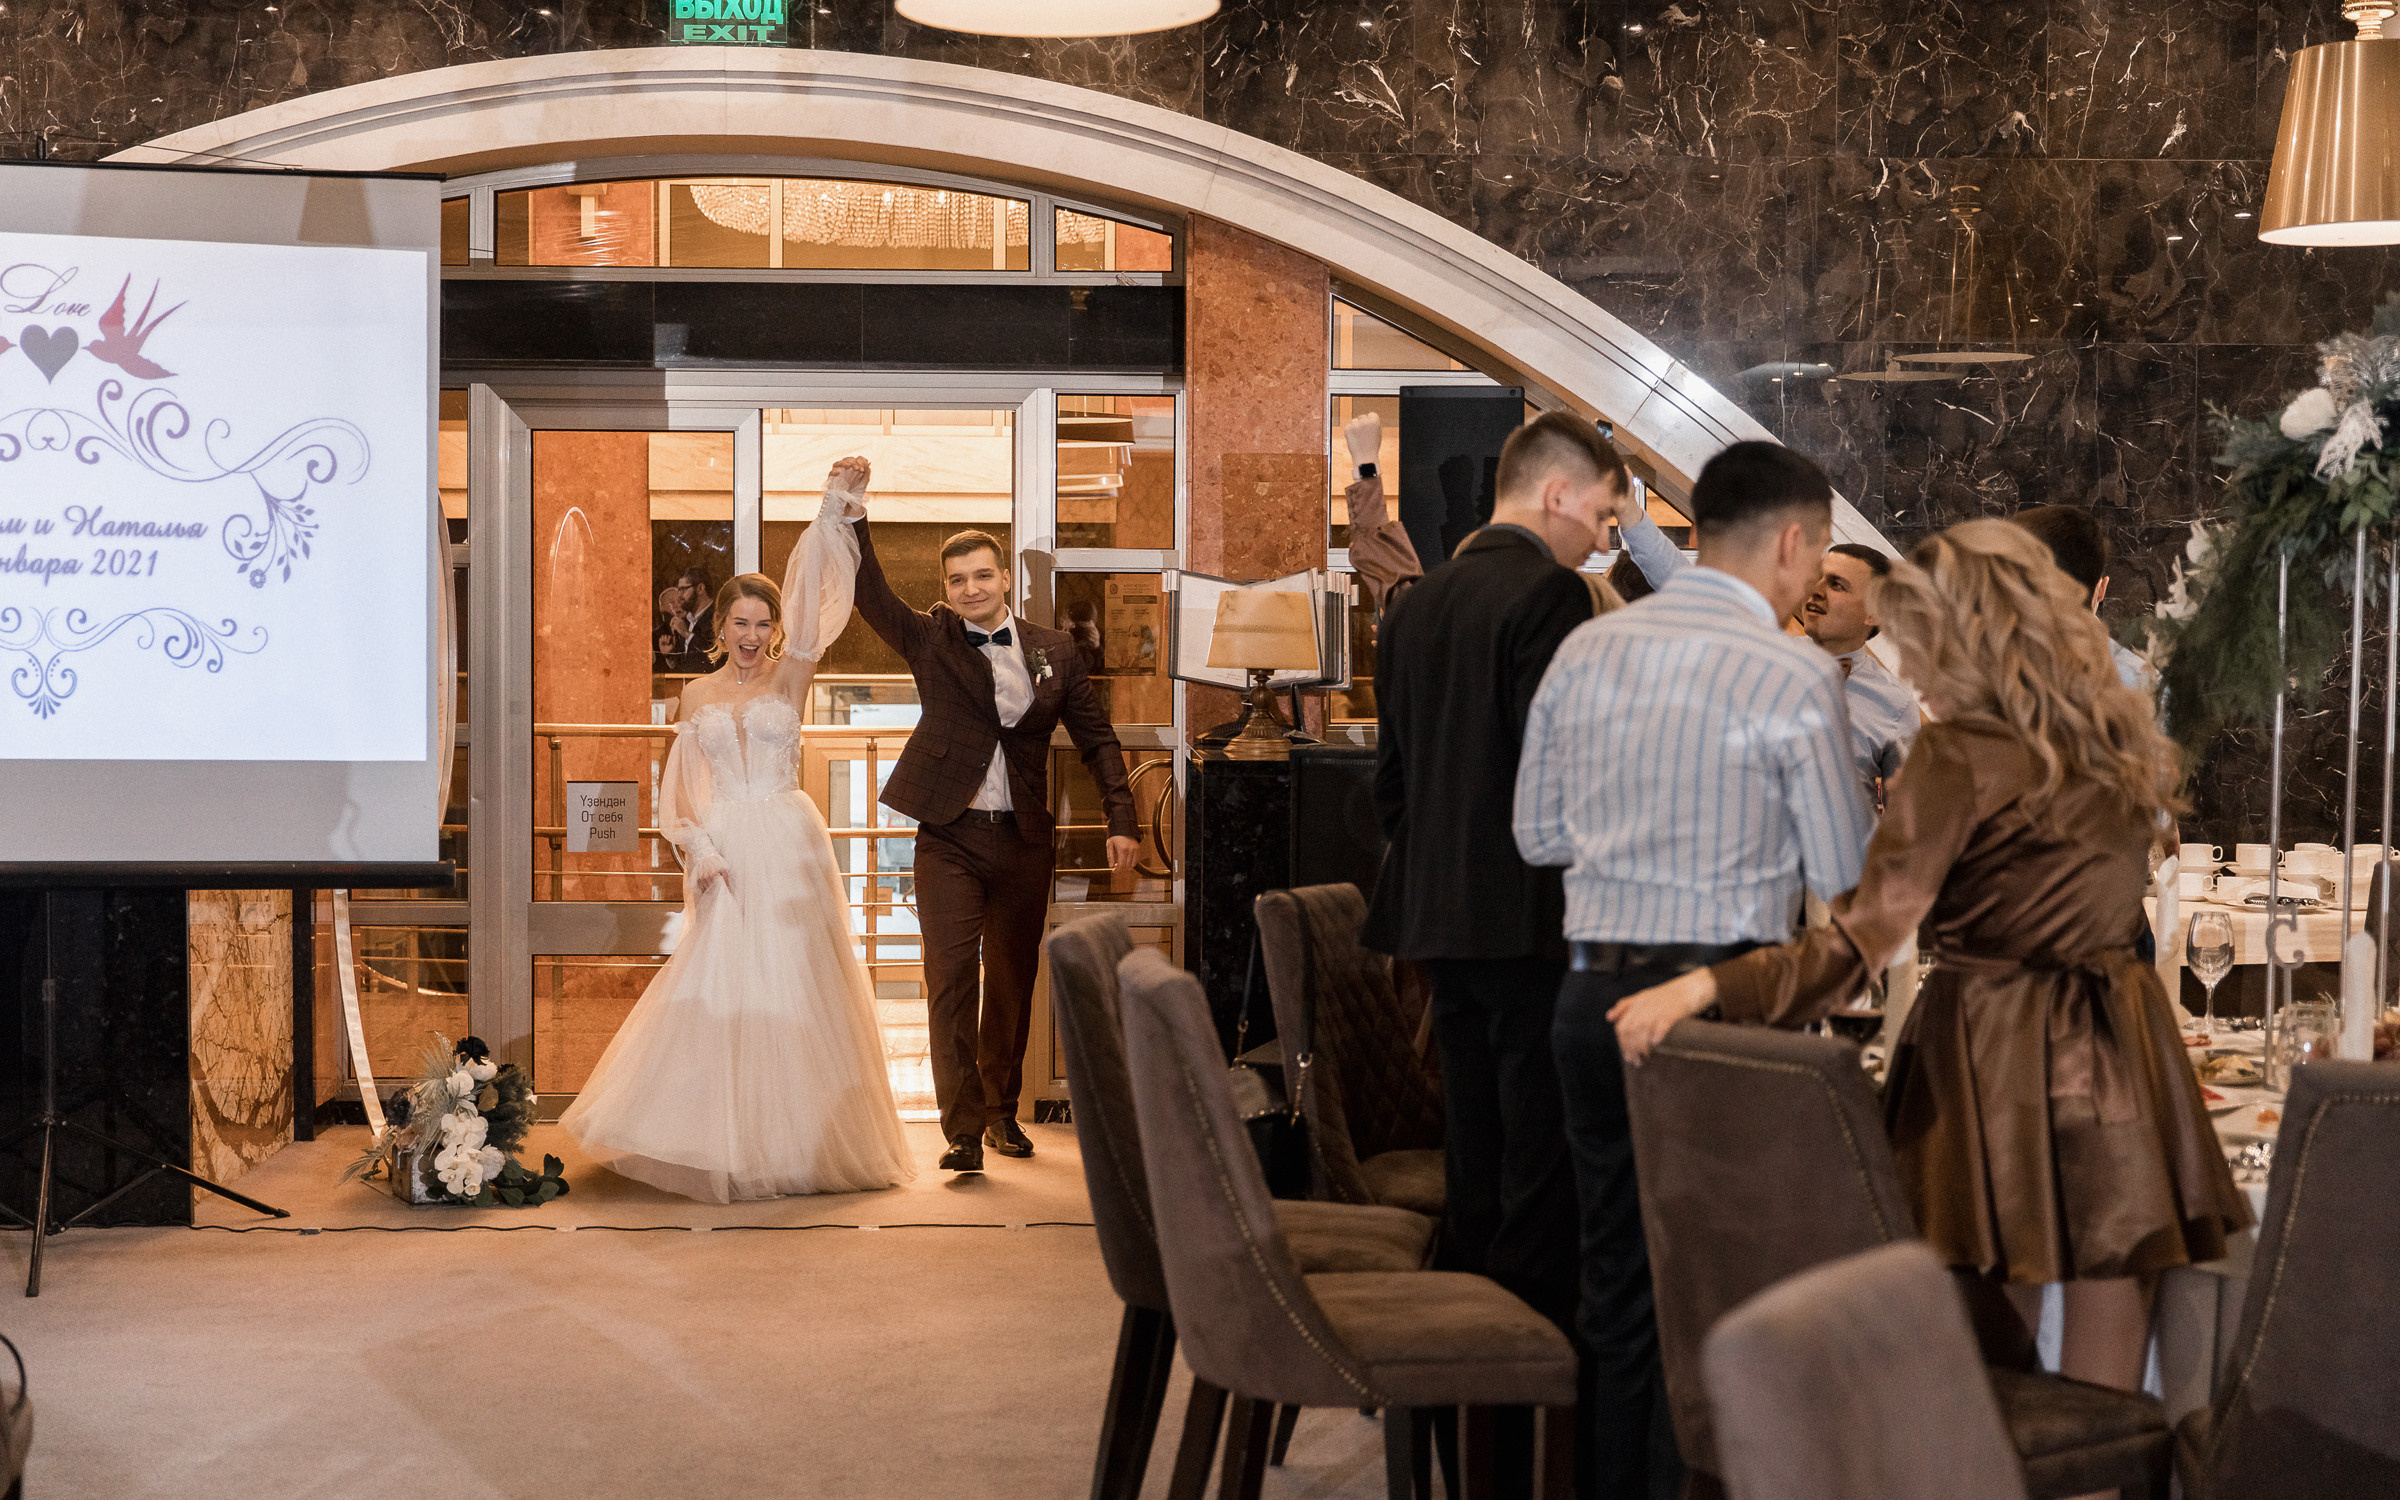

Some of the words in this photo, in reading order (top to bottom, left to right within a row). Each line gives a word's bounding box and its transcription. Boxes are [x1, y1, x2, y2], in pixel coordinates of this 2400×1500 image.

[675, 0, 784, 25] ВЫХОД
[683, 24, 776, 42] EXIT
[0, 263, 91, 317] Love
[34, 518, 55, 535] и
[64, 504, 208, 538] Наталья
[0, 542, 84, 588] нваря
[90, 548, 158, 576] 2021
[581, 810, 595, 823] От
[598, 811, 624, 823] себя
[589, 826, 616, 839] Push
